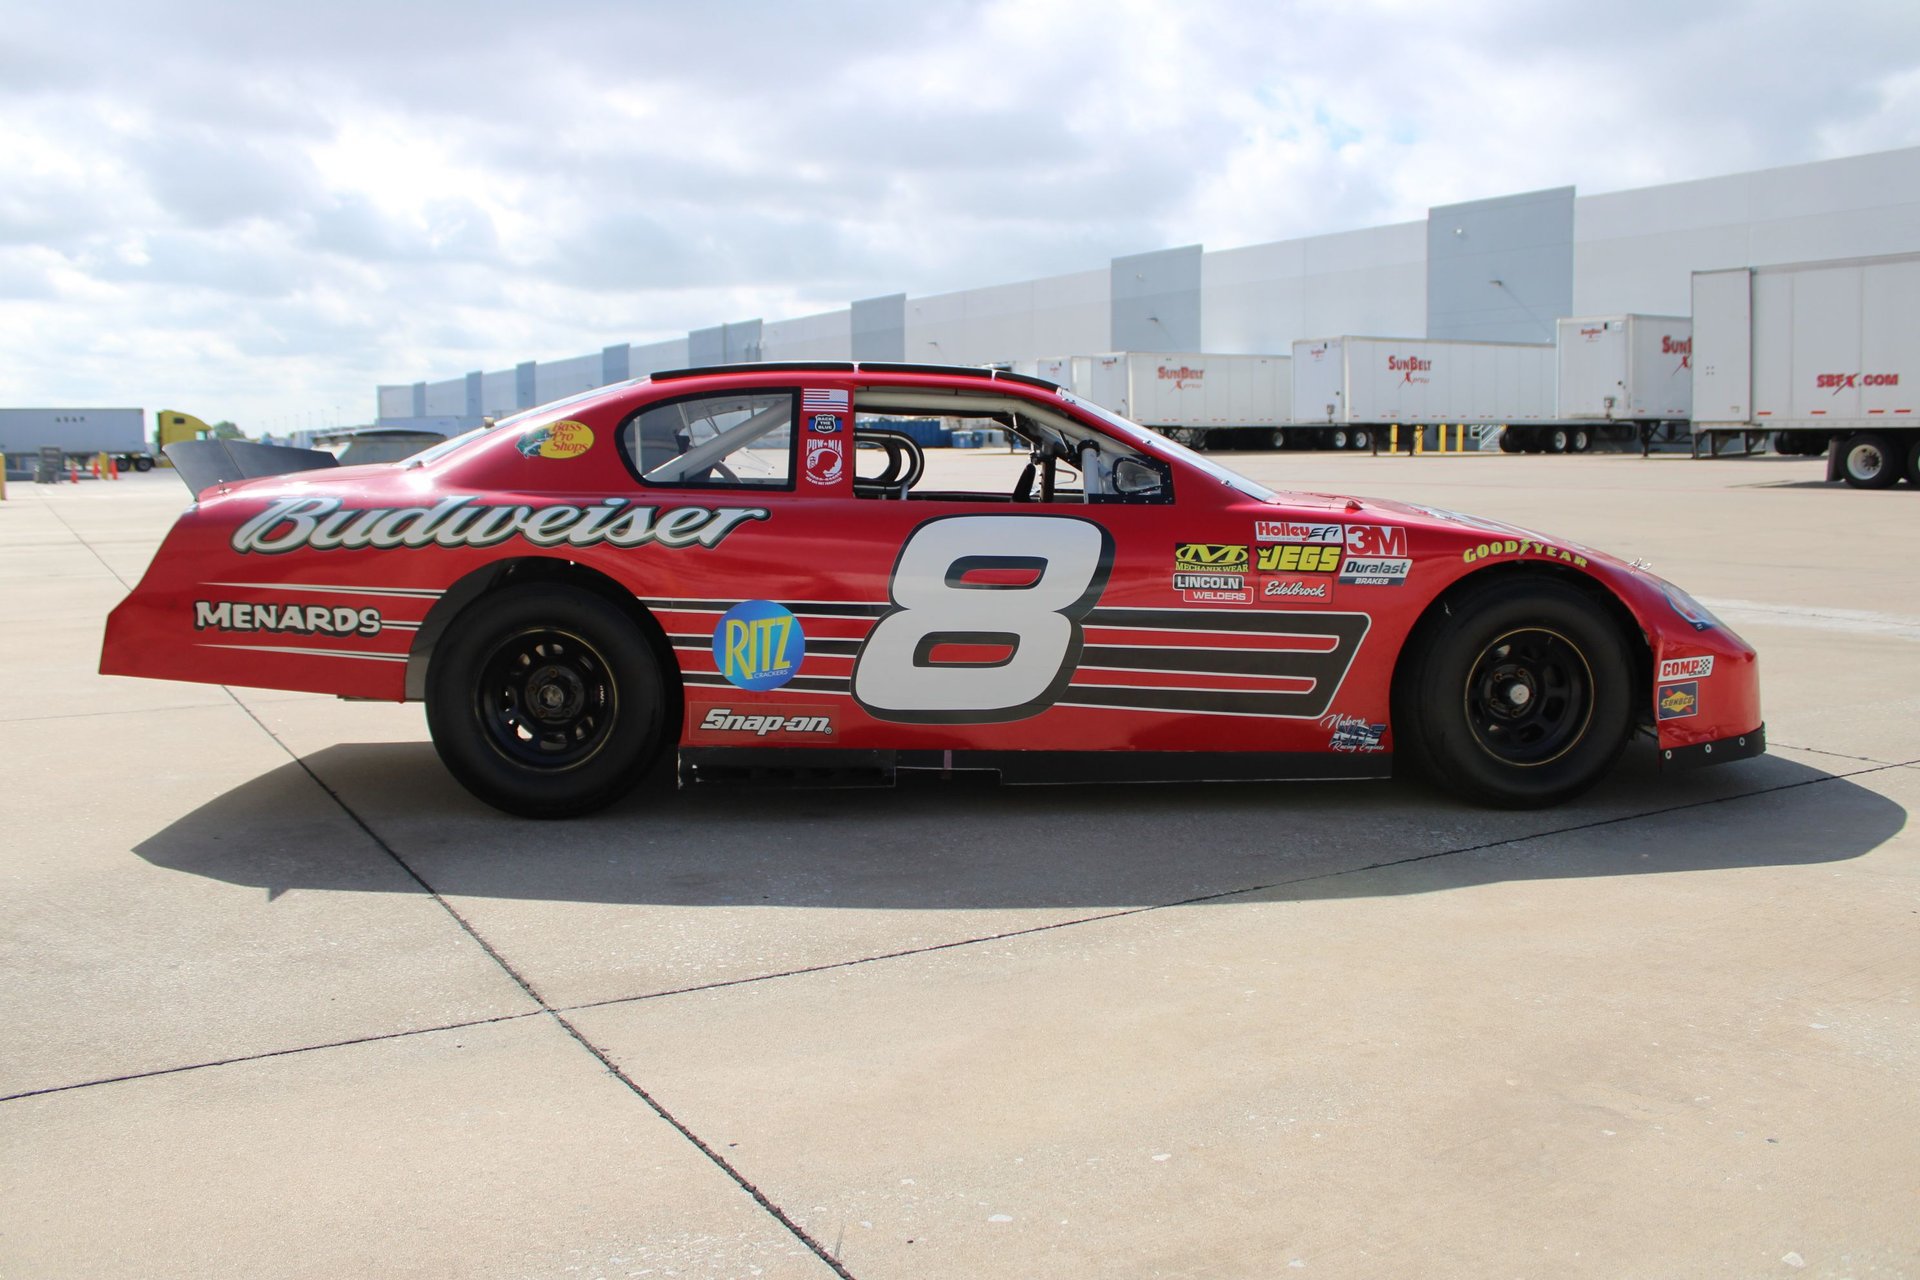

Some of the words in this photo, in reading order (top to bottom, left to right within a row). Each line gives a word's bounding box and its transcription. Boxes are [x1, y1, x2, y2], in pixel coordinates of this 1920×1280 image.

[553, 422, 582, 432] Bass
[553, 431, 574, 442] Pro
[551, 442, 589, 454] Shops
[231, 496, 772, 554] Budweiser
[1257, 521, 1310, 541] Holley
[1308, 526, 1339, 541] EFI
[1347, 525, 1406, 556] 3M
[1257, 545, 1342, 571] JEGS
[1222, 564, 1249, 573] WEAR
[1345, 561, 1407, 574] Duralast
[1177, 576, 1240, 590] LINCOLN
[1355, 577, 1389, 585] BRAKES
[1193, 591, 1246, 600] WELDERS
[1264, 580, 1326, 597] Edelbrock
[193, 600, 382, 638] MENARDS
[851, 513, 1115, 724] 8
[724, 615, 793, 680] RITZ
[754, 669, 789, 679] CRACKERS
[1662, 659, 1700, 677] COMP
[1662, 696, 1694, 708] SUNOCO
